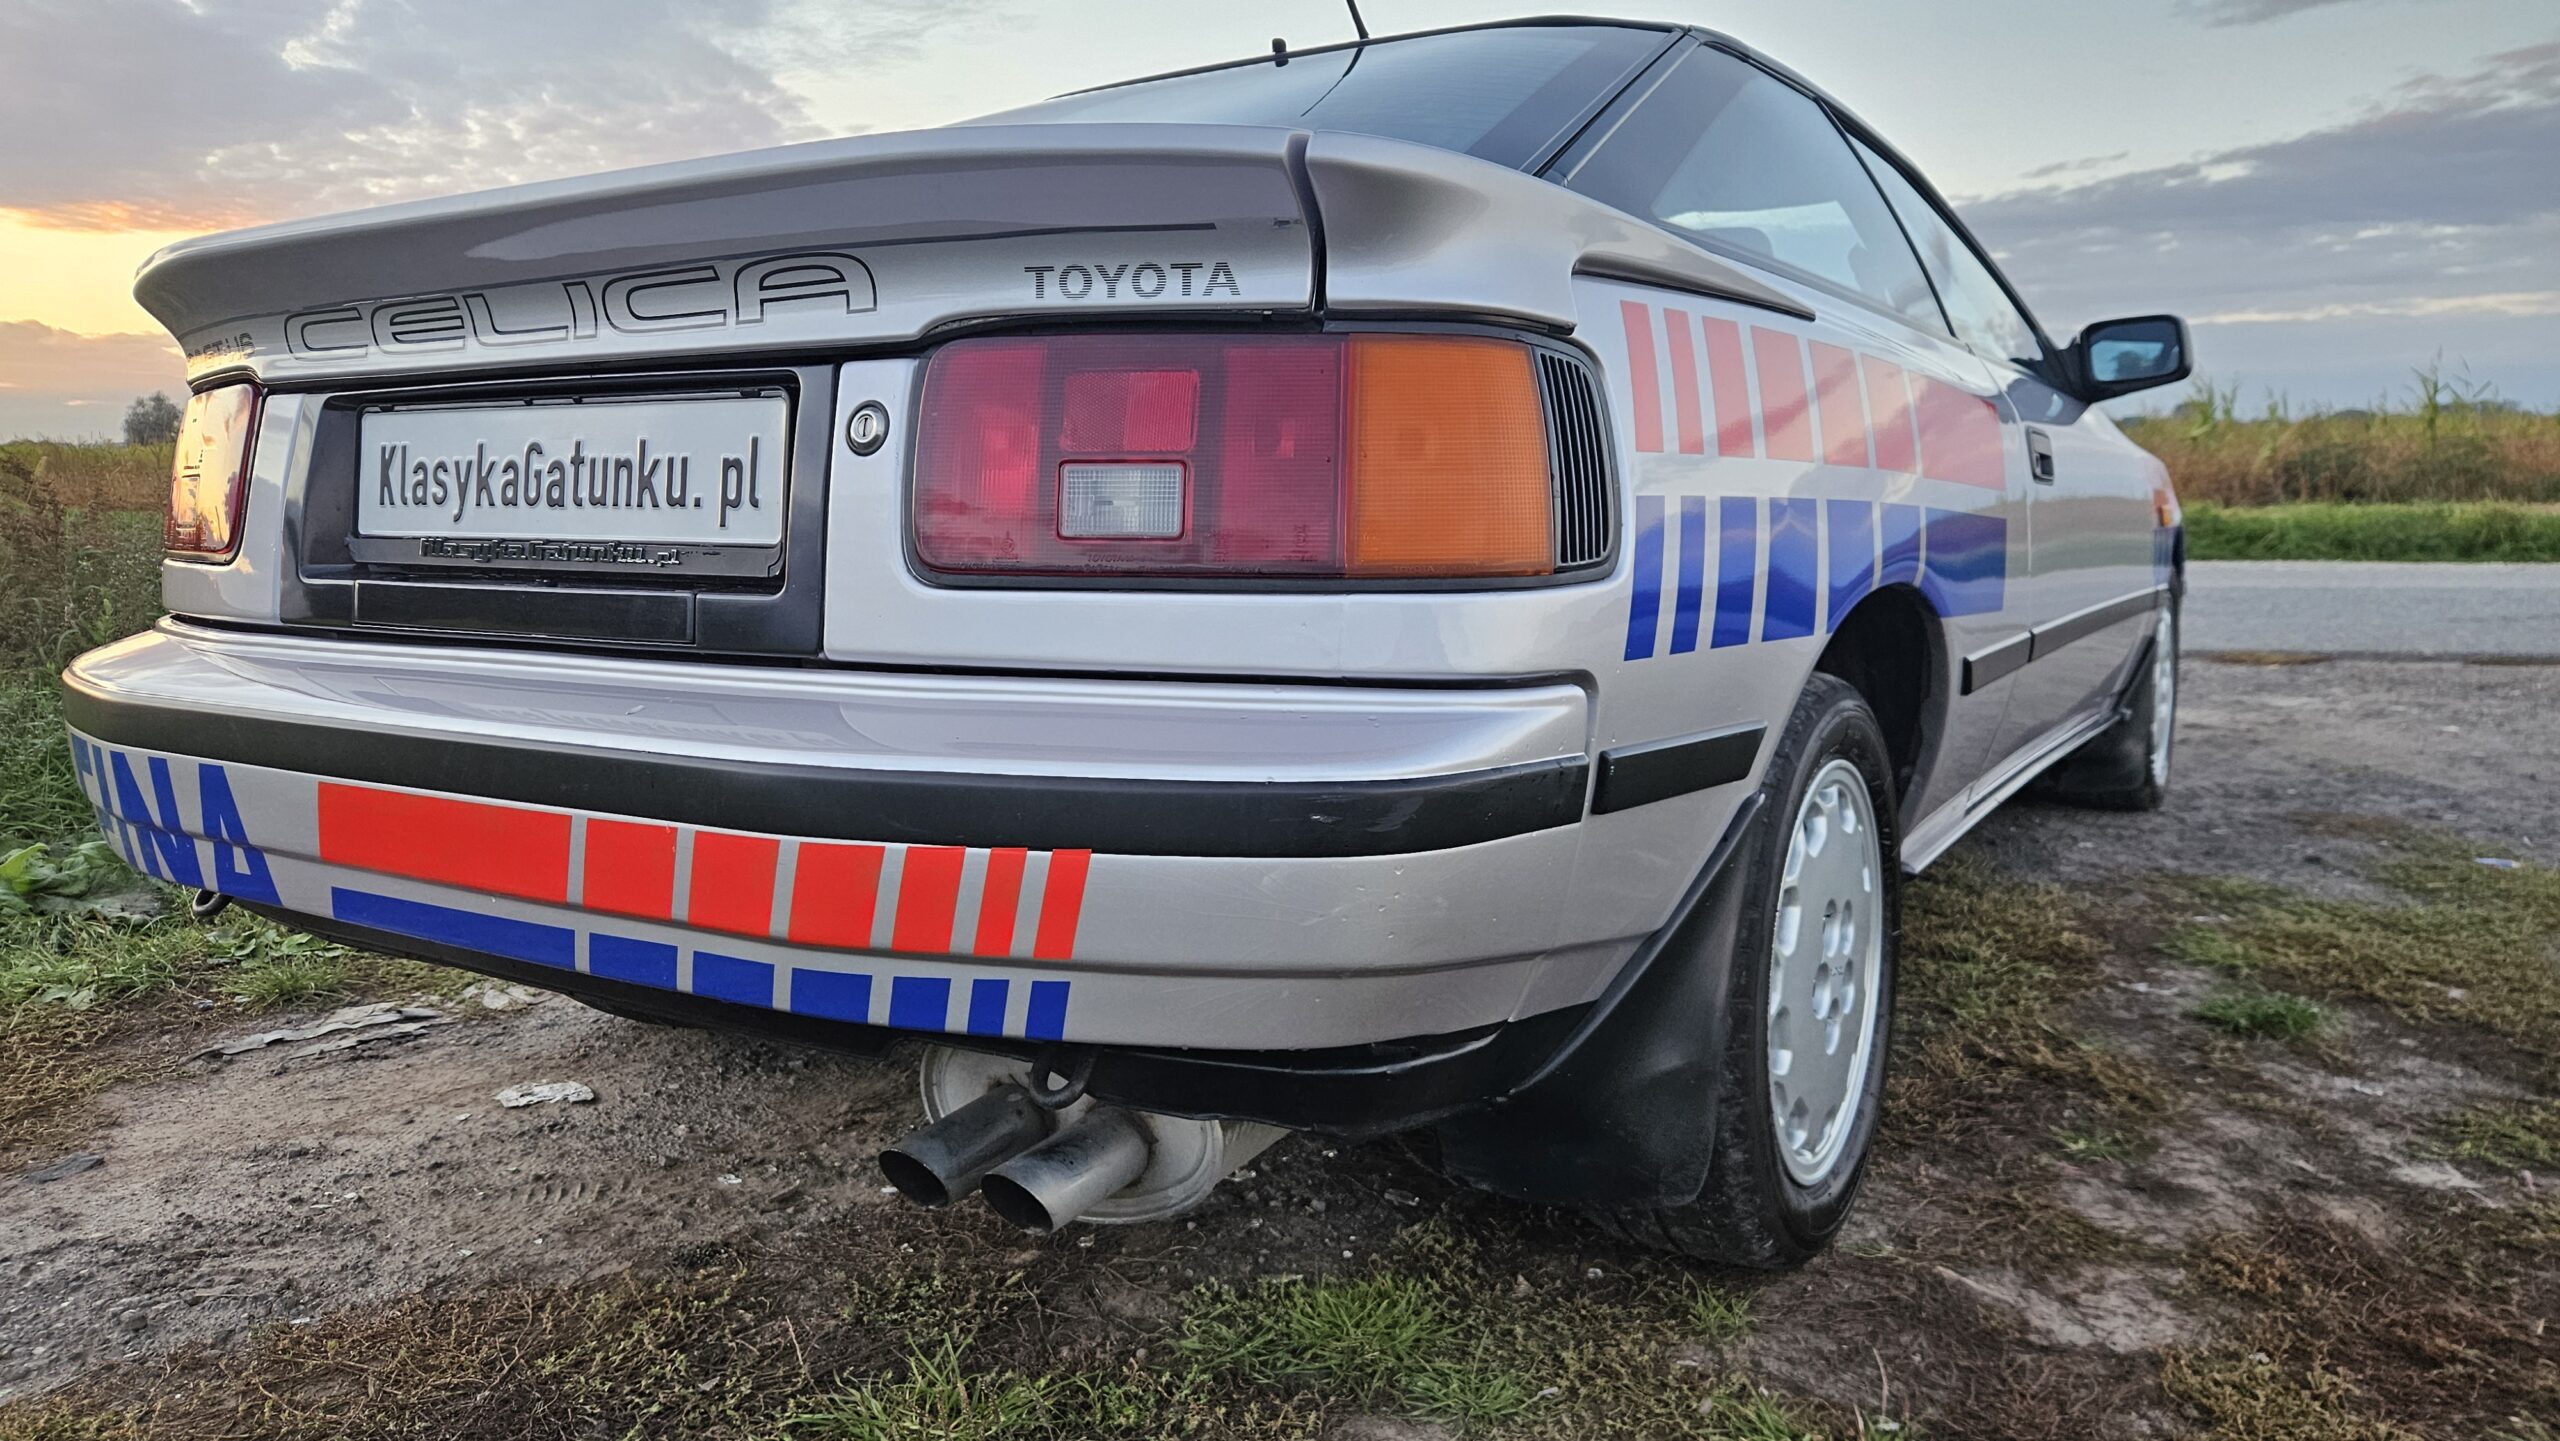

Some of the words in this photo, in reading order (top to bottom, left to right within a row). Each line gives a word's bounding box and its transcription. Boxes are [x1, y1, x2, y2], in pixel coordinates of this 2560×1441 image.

[284, 252, 878, 361] CELICA
[1024, 261, 1241, 300] TOYOTA
[71, 732, 284, 907] FINA
